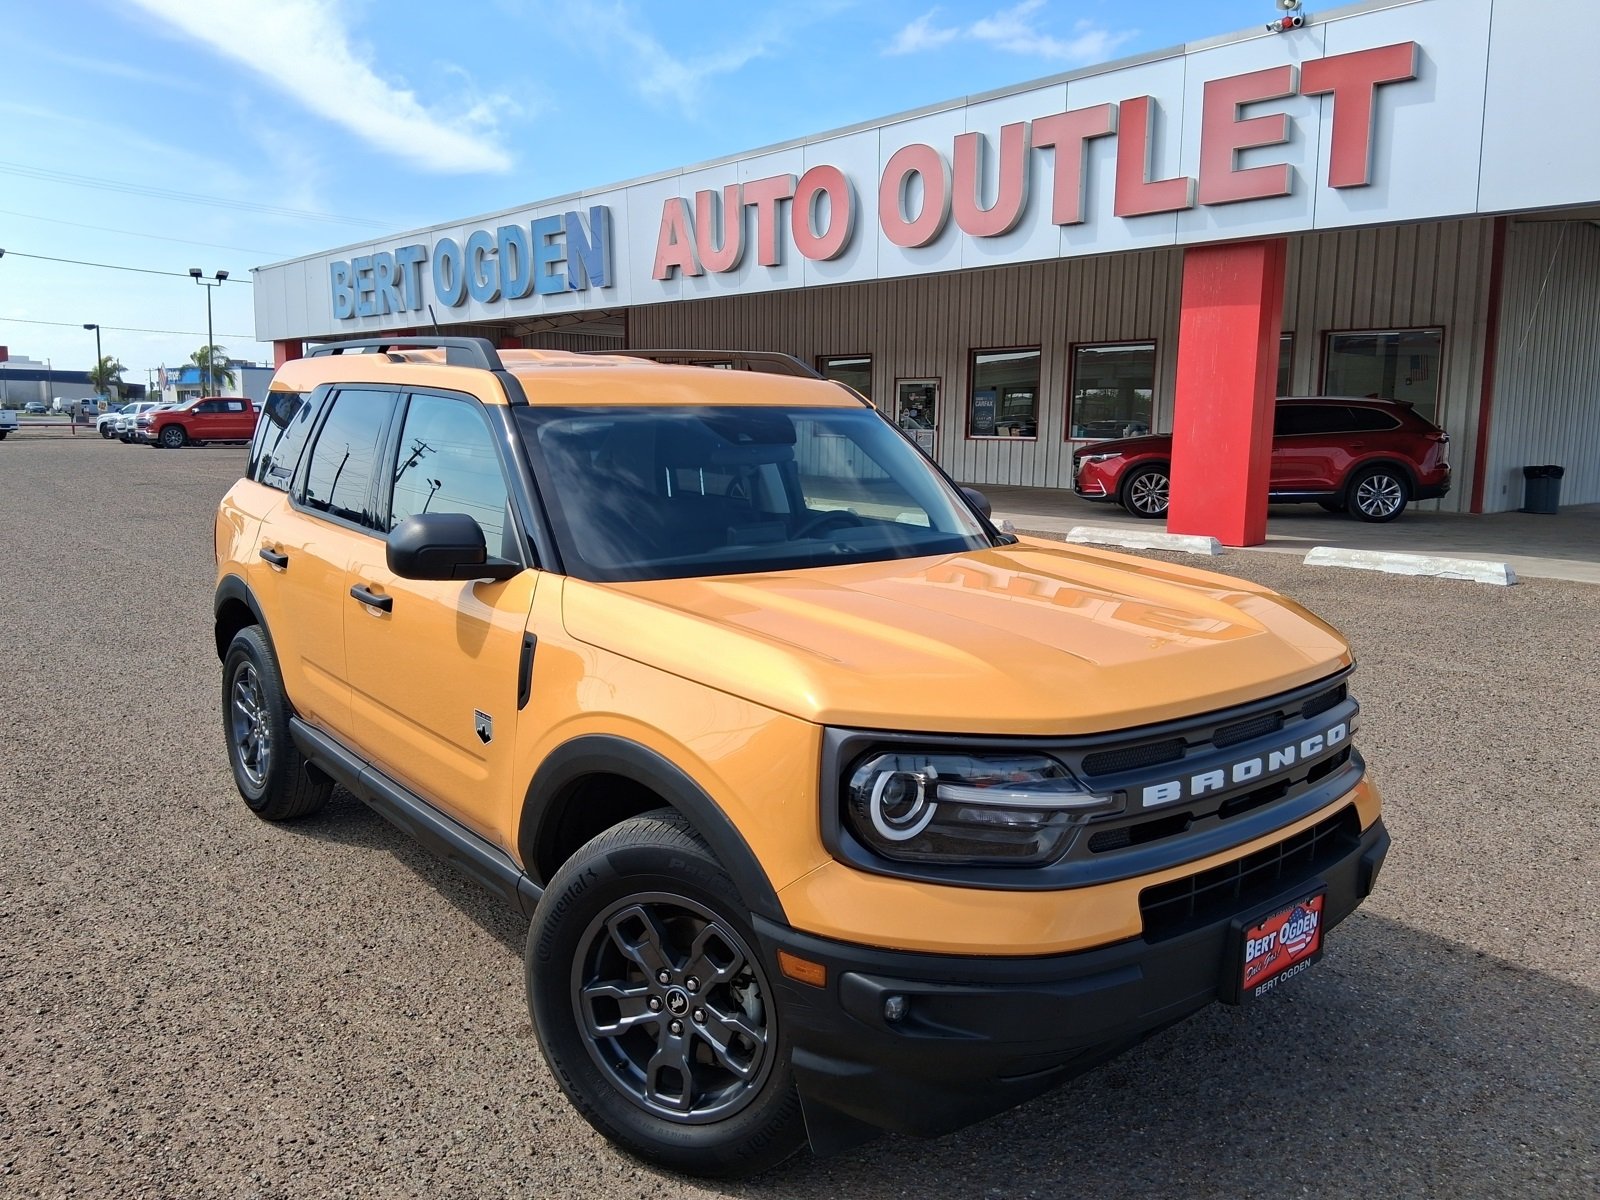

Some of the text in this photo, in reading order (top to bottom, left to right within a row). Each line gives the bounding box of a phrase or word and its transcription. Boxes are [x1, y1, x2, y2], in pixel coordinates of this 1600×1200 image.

[330, 41, 1419, 320] BERT OGDEN AUTO OUTLET
[1142, 722, 1346, 808] BRONCO
[1246, 911, 1319, 963] BERT OGDEN
[1255, 958, 1311, 997] BERT OGDEN
